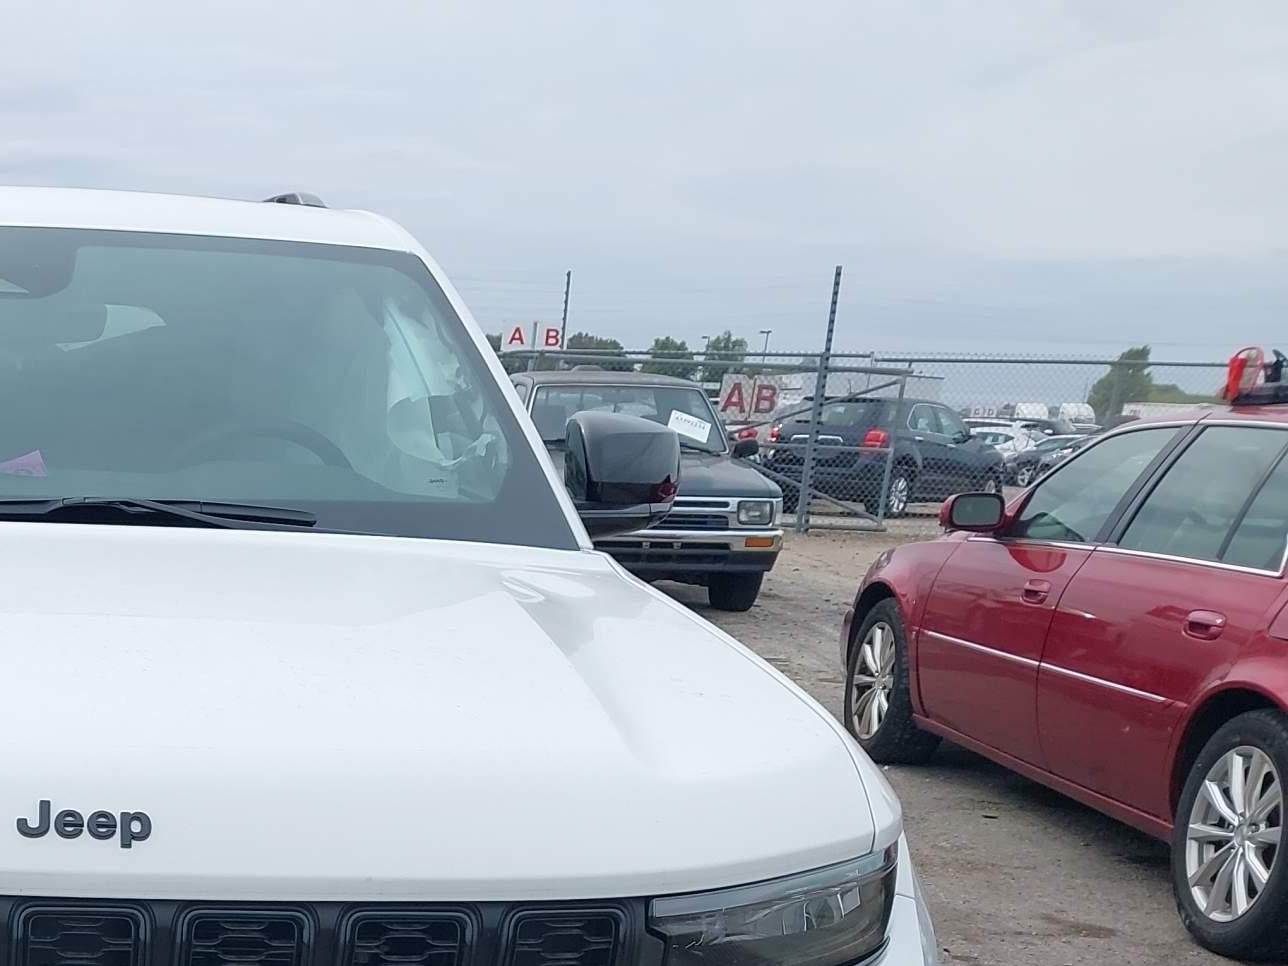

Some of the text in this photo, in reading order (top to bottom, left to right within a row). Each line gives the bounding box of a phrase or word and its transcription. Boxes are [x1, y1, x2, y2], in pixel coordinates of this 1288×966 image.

[508, 326, 560, 346] A B
[720, 382, 777, 413] A B
[16, 800, 152, 849] Jeep
